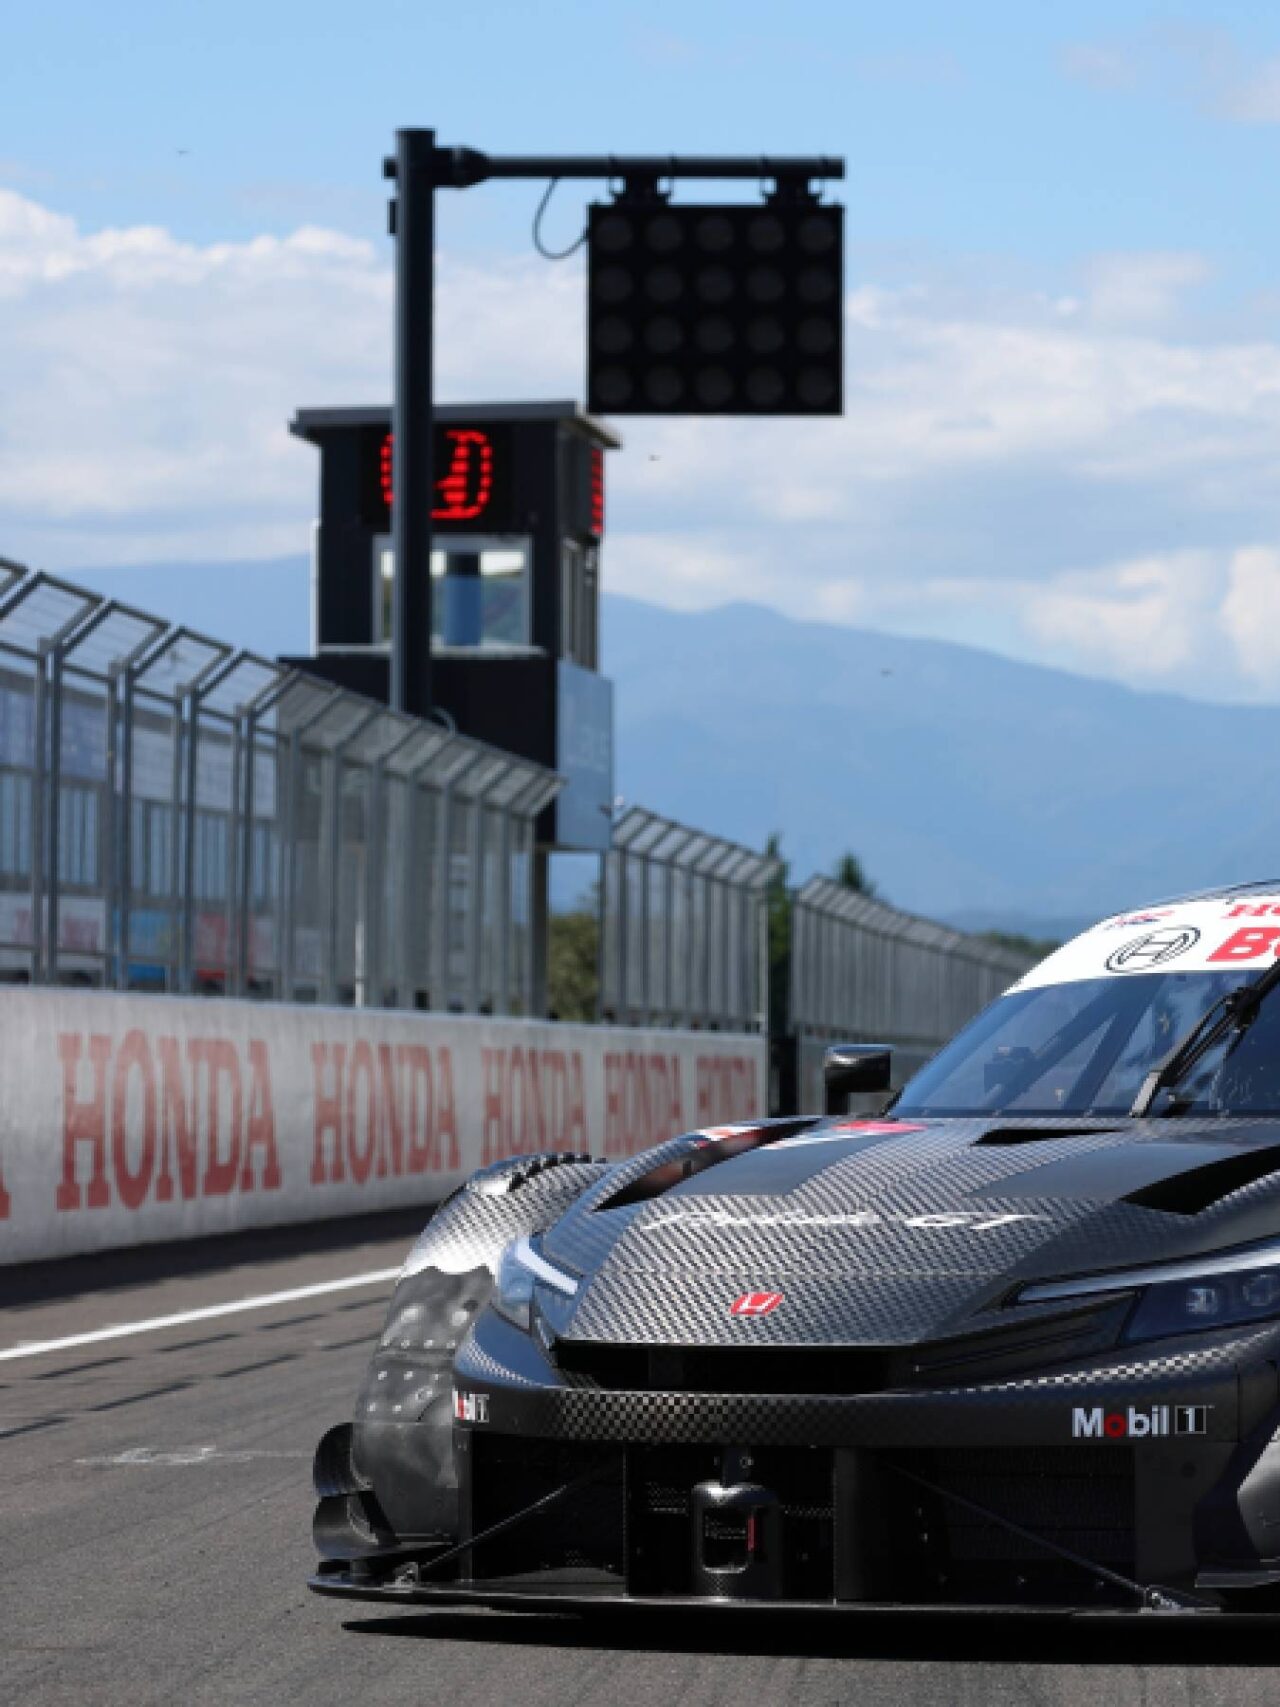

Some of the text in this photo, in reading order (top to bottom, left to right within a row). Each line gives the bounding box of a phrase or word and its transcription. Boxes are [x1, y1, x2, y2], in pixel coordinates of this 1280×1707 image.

[55, 1029, 283, 1212] HONDA
[310, 1038, 461, 1187] HONDA
[480, 1046, 590, 1168] HONDA
[1072, 1405, 1170, 1438] Mobil
